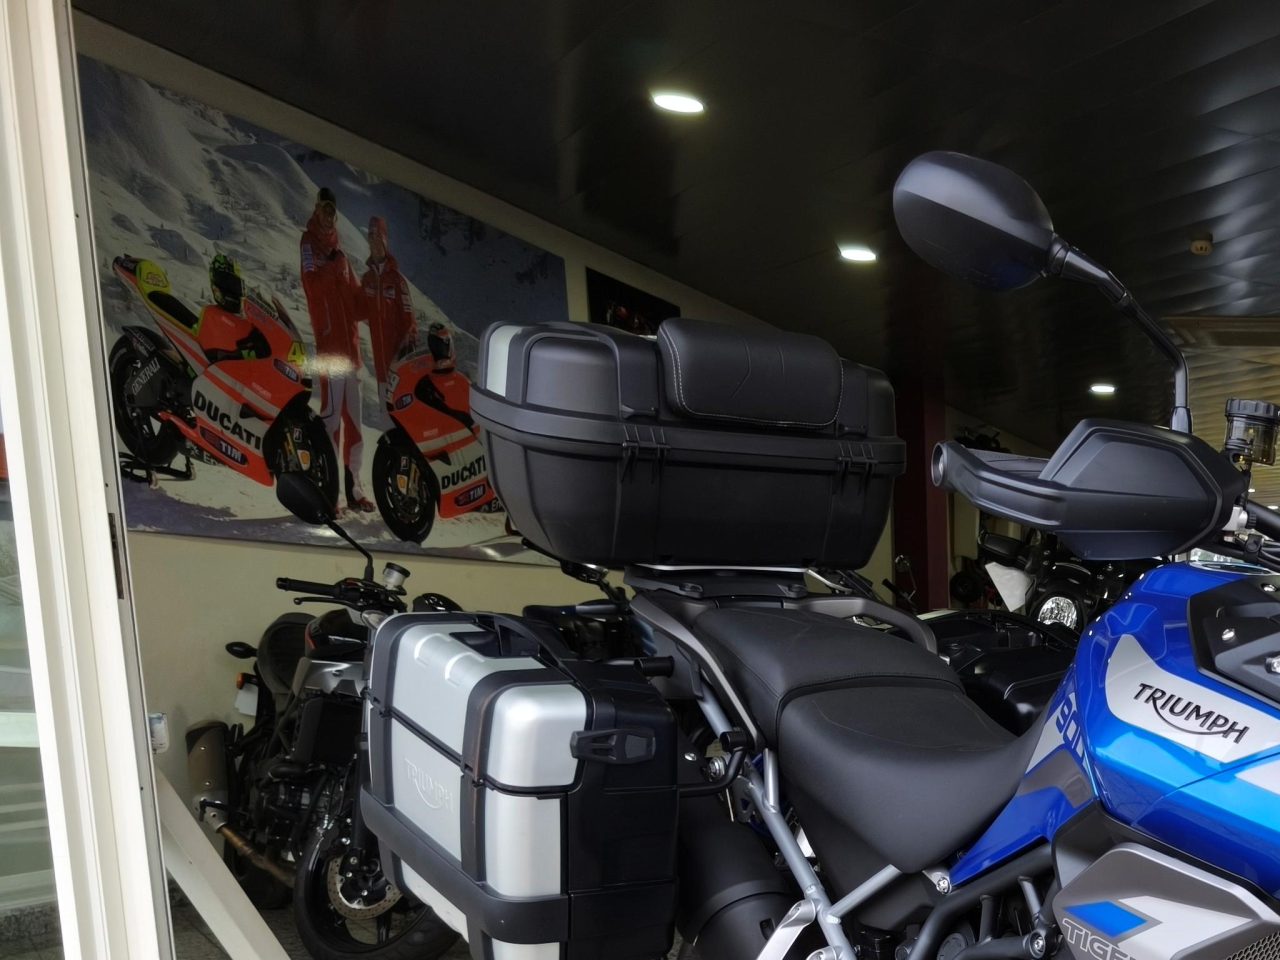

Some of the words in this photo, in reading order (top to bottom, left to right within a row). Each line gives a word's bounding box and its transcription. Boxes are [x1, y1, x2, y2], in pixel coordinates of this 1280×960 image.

[132, 357, 161, 395] GENERALI
[194, 390, 261, 450] DUCATI
[220, 441, 242, 462] TIM
[441, 455, 486, 489] DUCATI
[469, 486, 484, 500] TIM
[1133, 683, 1250, 744] TRIUMPH
[404, 757, 455, 815] TRIUMPH
